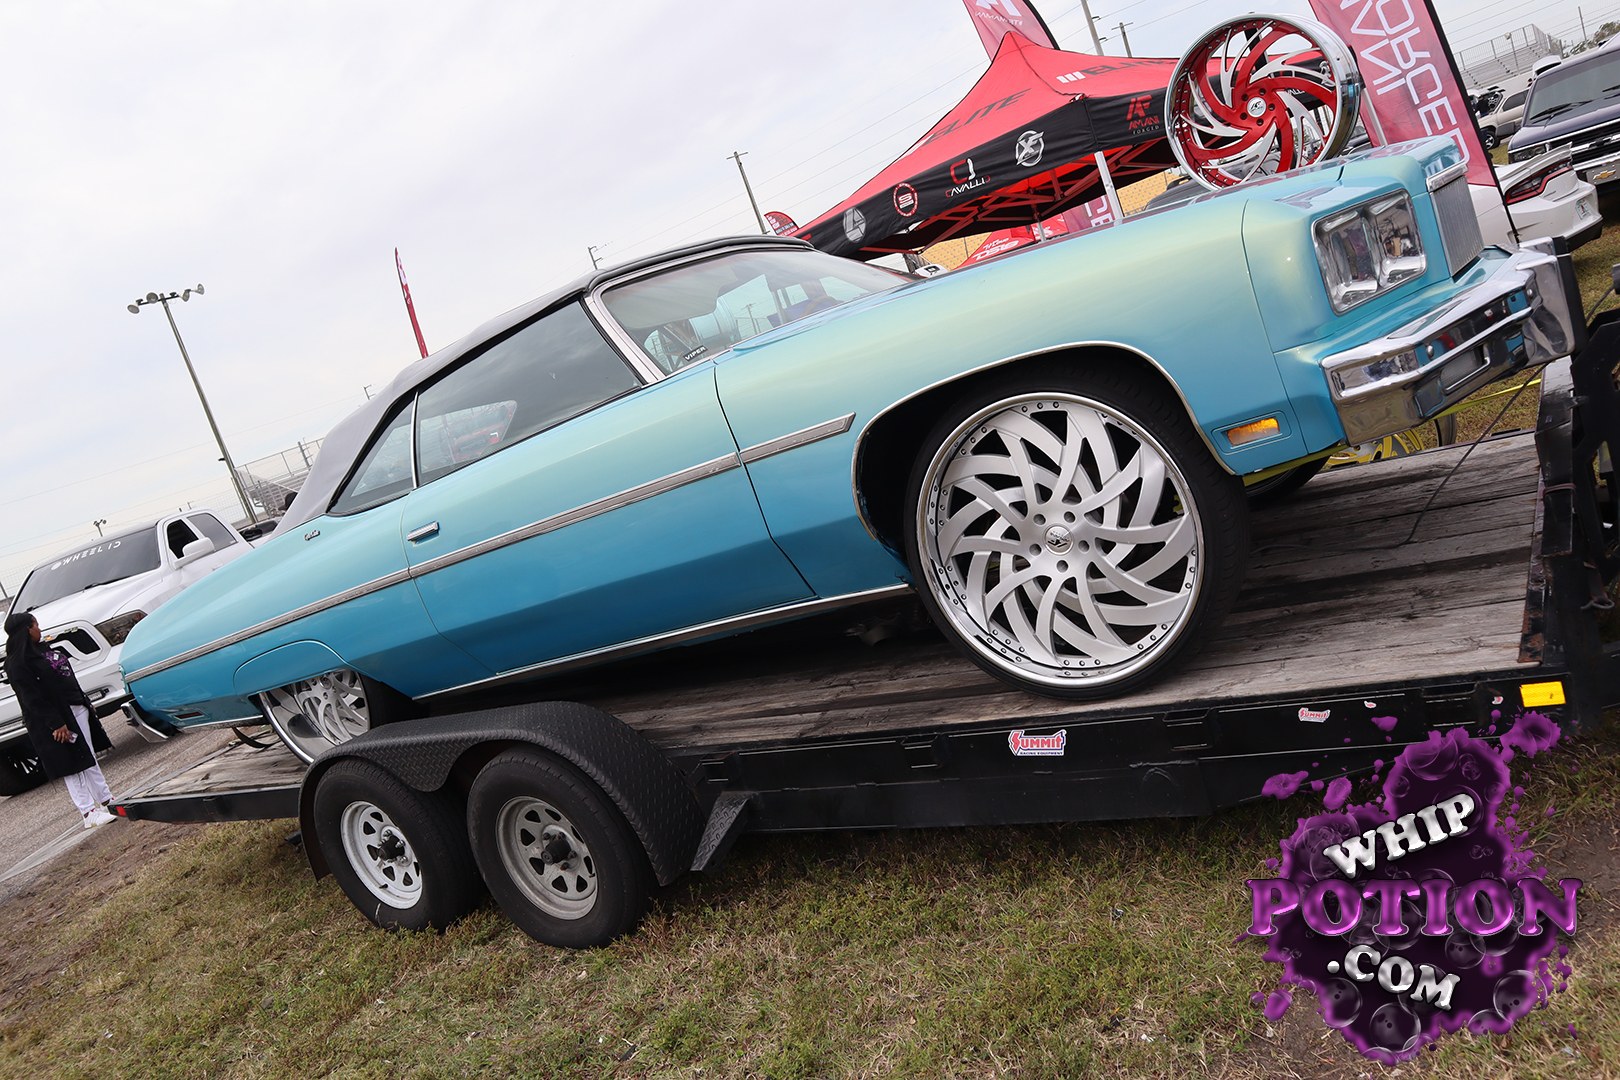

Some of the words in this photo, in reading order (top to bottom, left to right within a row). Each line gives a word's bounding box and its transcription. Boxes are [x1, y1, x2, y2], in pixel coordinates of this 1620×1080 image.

[920, 87, 1032, 147] ELITE
[1129, 115, 1160, 130] AMANI
[684, 346, 706, 361] VIPER
[1011, 731, 1063, 752] SUMMIT
